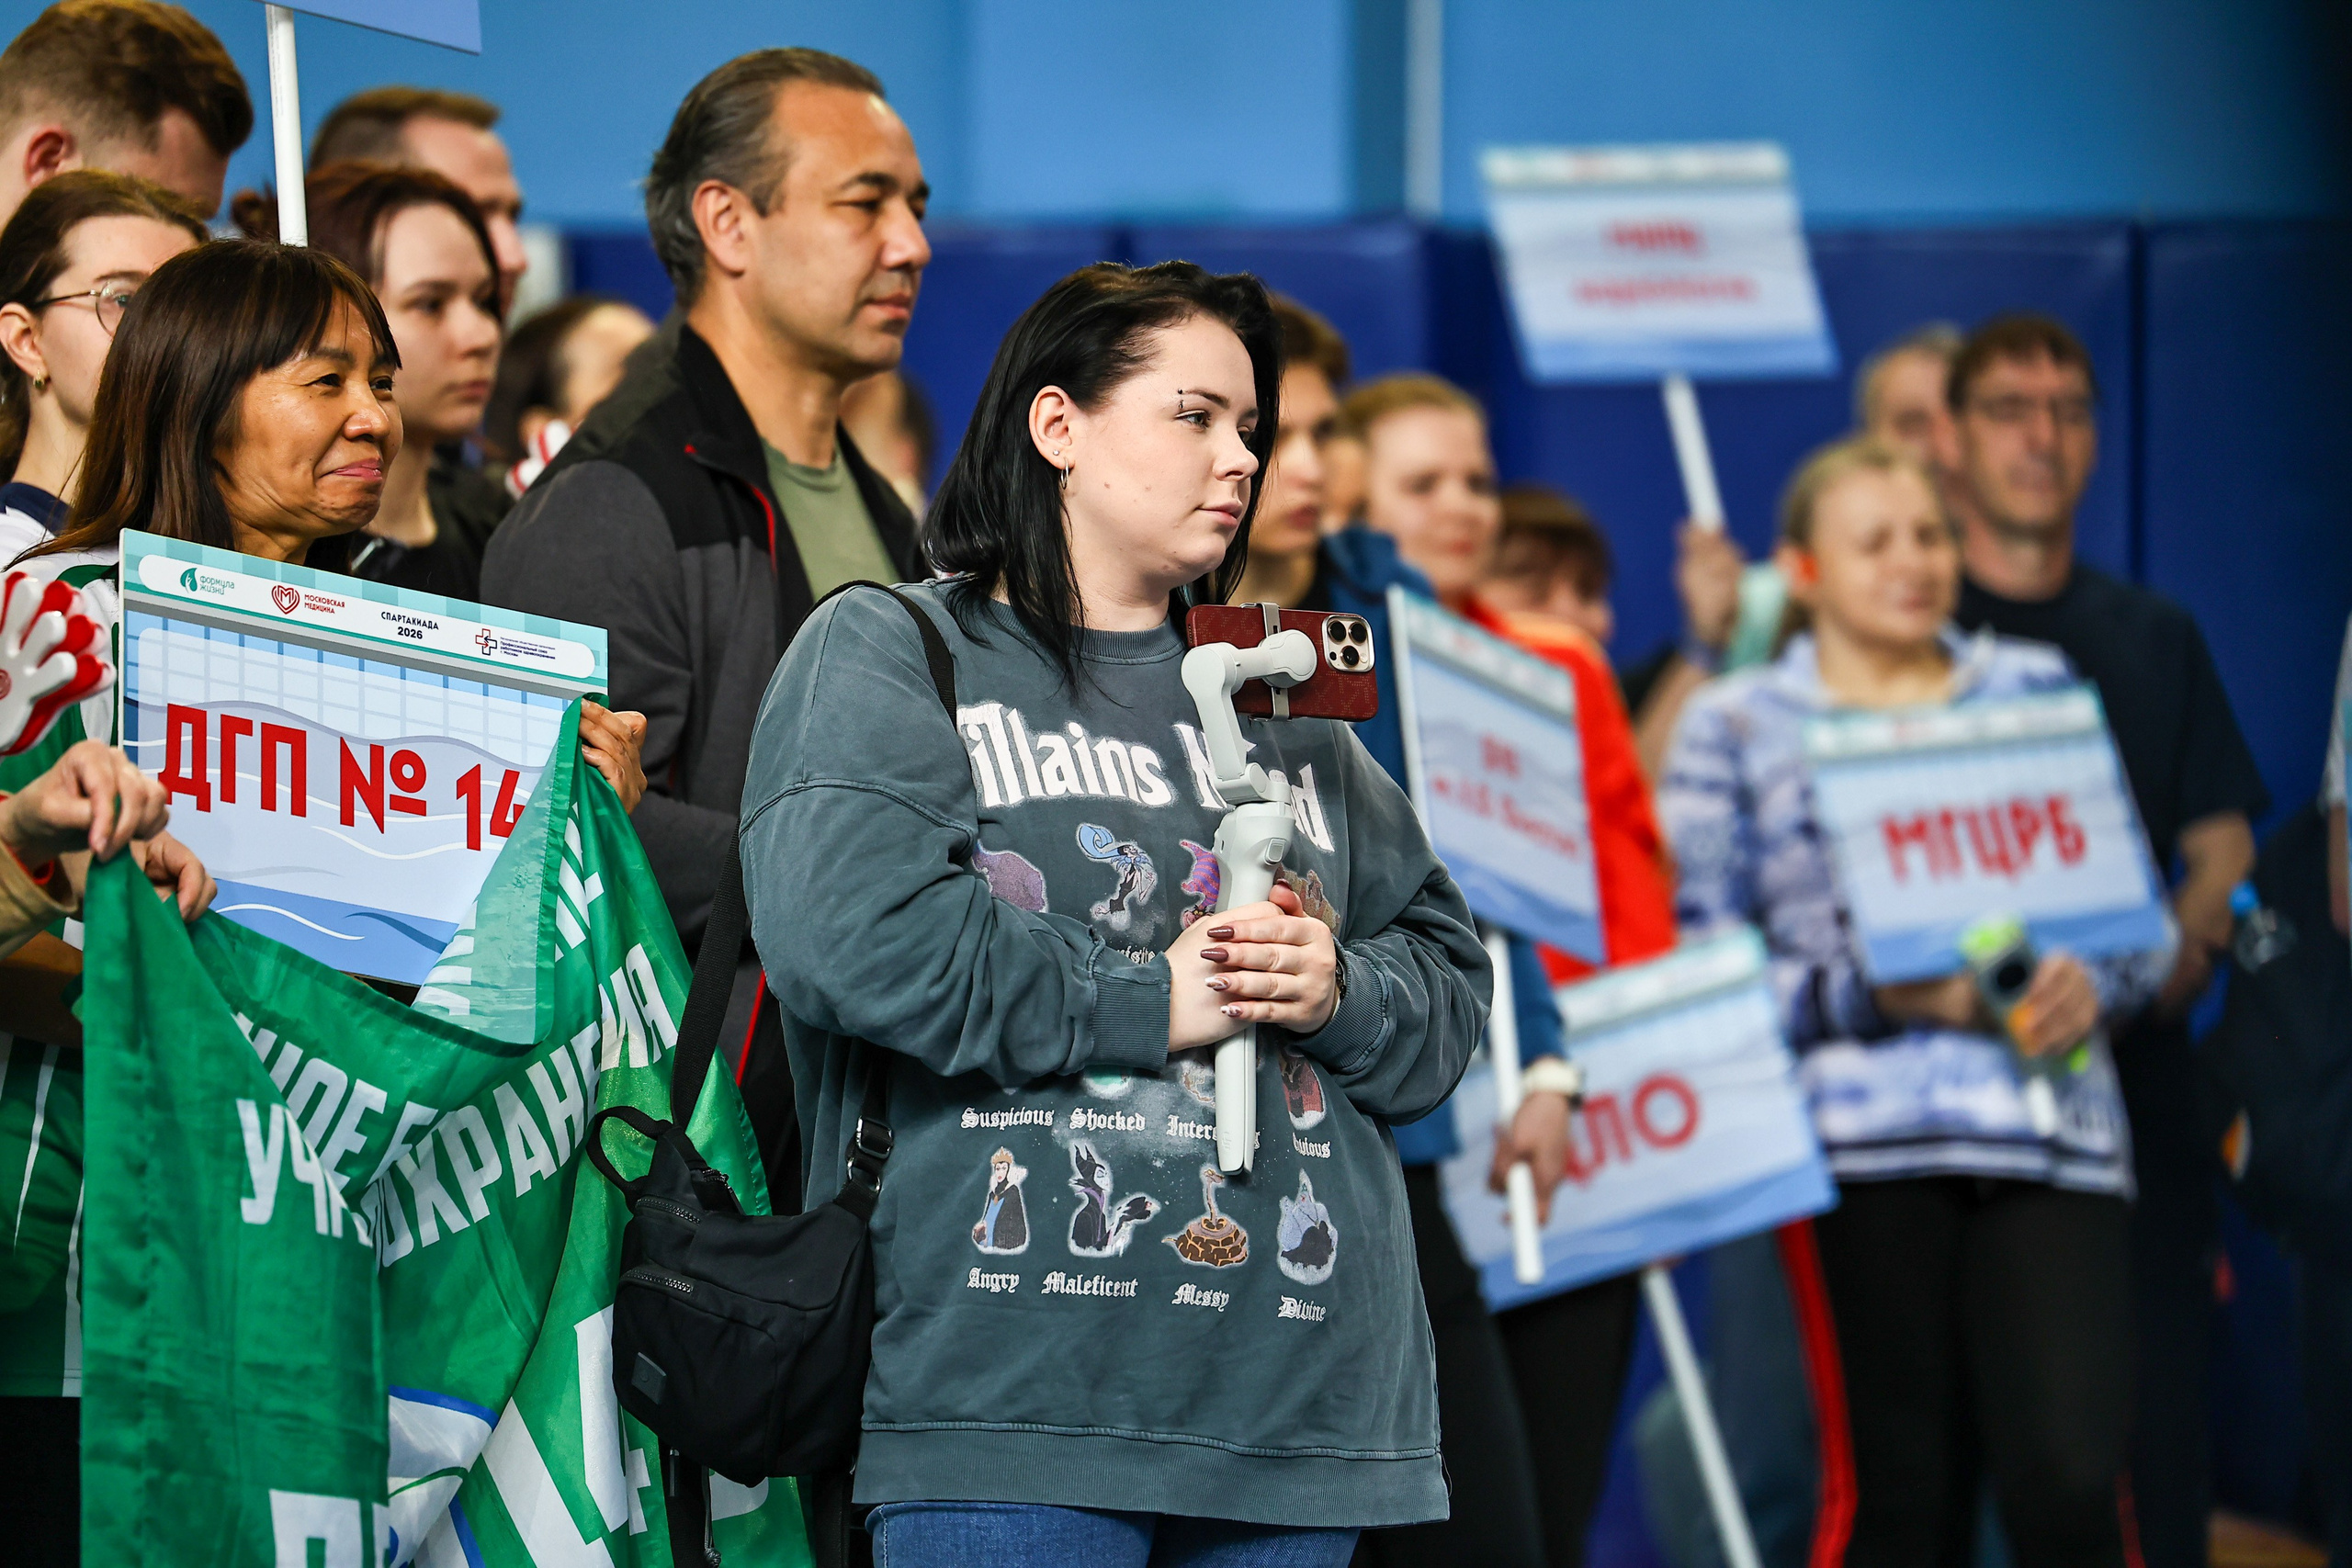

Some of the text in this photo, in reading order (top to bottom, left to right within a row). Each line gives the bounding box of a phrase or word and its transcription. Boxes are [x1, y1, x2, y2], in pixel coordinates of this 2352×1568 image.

[199, 575, 235, 590] формула
[199, 584, 225, 595] жизни
[304, 593, 345, 608] МОСКОВСКАЯ
[304, 602, 335, 615] МЕДИЦИНА
[380, 611, 439, 630] СПАРТАКИАДА
[397, 626, 423, 639] 2026
[956, 703, 1172, 807] illains
[158, 703, 307, 818] ДГП
[340, 737, 427, 834] №
[1879, 794, 2086, 885] МГЦРБ
[961, 1106, 1055, 1131] Suspicious
[1069, 1108, 1146, 1131] Shocked
[967, 1267, 1020, 1293] Angry
[1041, 1270, 1139, 1298] Maleficent
[1171, 1282, 1230, 1313] Messy
[1277, 1294, 1327, 1322] Divine
